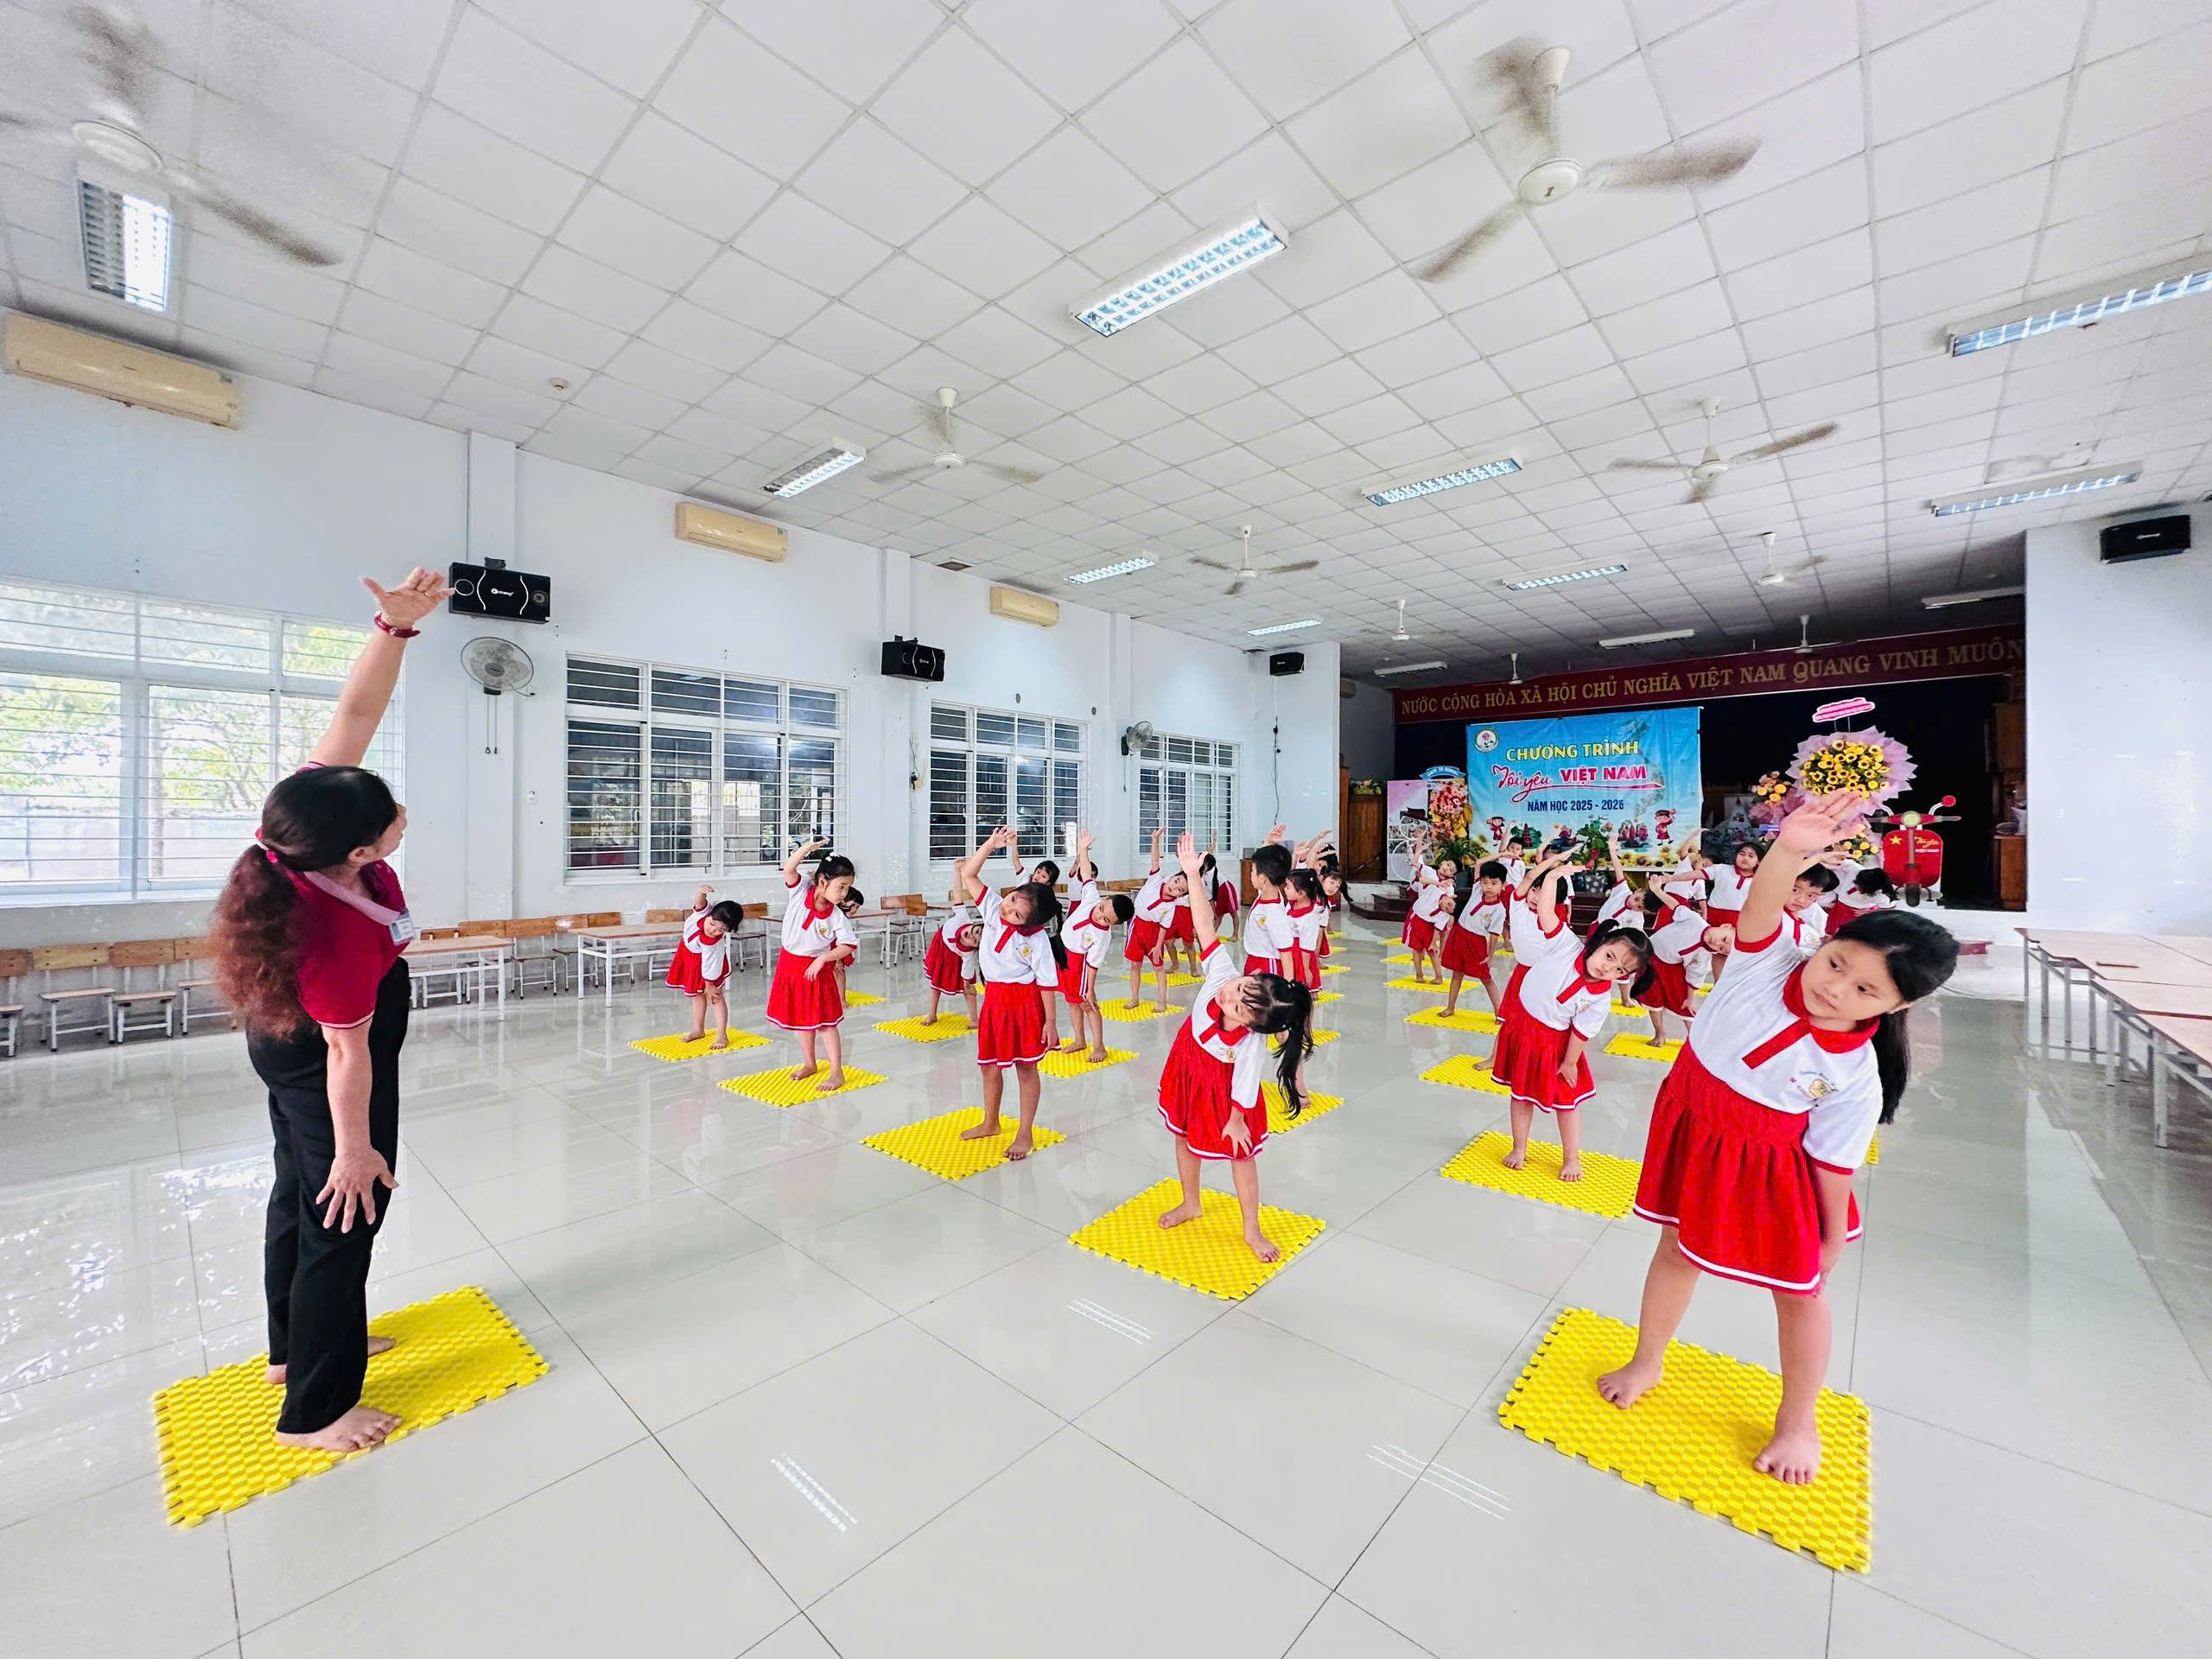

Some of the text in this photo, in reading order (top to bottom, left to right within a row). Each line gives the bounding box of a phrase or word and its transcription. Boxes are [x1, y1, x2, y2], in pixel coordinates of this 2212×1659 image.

[1401, 695, 1439, 715] NƯỚC
[1441, 692, 1480, 713] CỘNG
[1484, 688, 1517, 708] HÒA
[1520, 684, 1543, 704] XÃ
[1548, 682, 1577, 704] HỘI
[1582, 675, 1618, 699] CHỦ
[1623, 672, 1682, 696] NGHĨA
[1687, 666, 1734, 690] VIỆT
[1738, 663, 1786, 684] NAM
[1793, 655, 1872, 683] QUANG
[1878, 648, 1939, 671] VINH
[1506, 739, 1640, 761] CHƯƠNG TRÌNH
[1492, 765, 1647, 803] Tôi yêu VIỆT NAM
[1528, 799, 1548, 812] NĂM
[1550, 800, 1568, 814] HỌC
[1570, 800, 1592, 811] 2025
[1601, 799, 1624, 810] 2026
